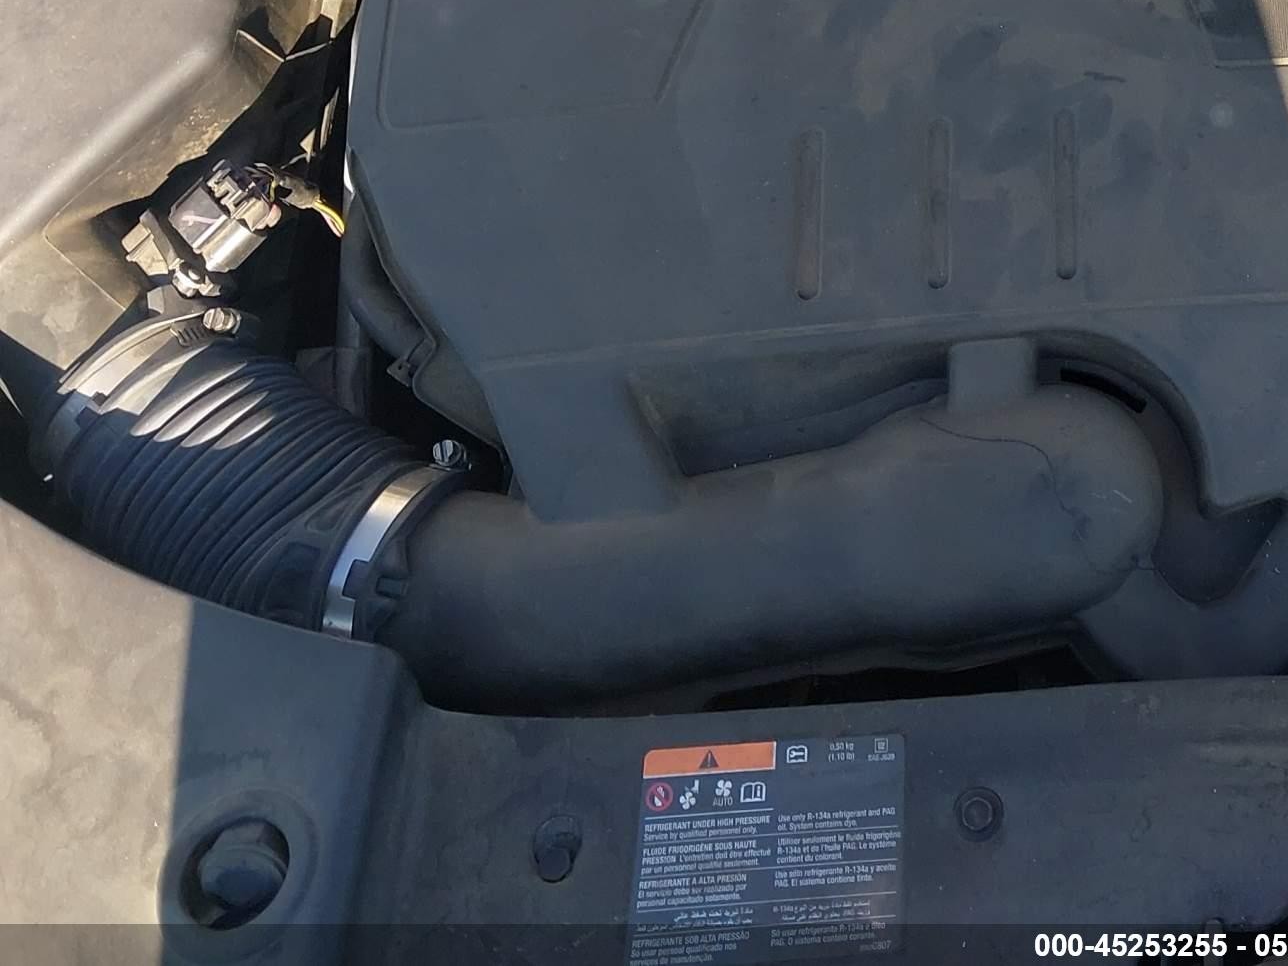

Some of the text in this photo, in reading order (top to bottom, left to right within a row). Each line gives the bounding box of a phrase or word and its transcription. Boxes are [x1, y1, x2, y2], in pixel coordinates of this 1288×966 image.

[712, 796, 733, 806] AUTO
[792, 813, 805, 822] only
[807, 811, 830, 819] R-134a
[832, 809, 866, 819] refrigerant
[644, 822, 690, 831] REFRIGERANT
[692, 819, 715, 828] UNDER
[734, 815, 770, 825] PRESSURE
[789, 822, 813, 831] System
[814, 819, 842, 828] contains
[643, 832, 668, 841] Service
[679, 829, 706, 838] qualified
[708, 827, 740, 837] personnel
[642, 840, 756, 855] FLUIDE FRIGORIGÈNE SOUS HAUTE
[776, 855, 803, 863] contient
[663, 863, 696, 873] personnel
[697, 861, 721, 870] qualifié
[639, 878, 690, 889] REFRIGERANTE
[698, 876, 715, 884] ALTA
[637, 898, 665, 907] personal
[667, 895, 703, 905] capacitado
